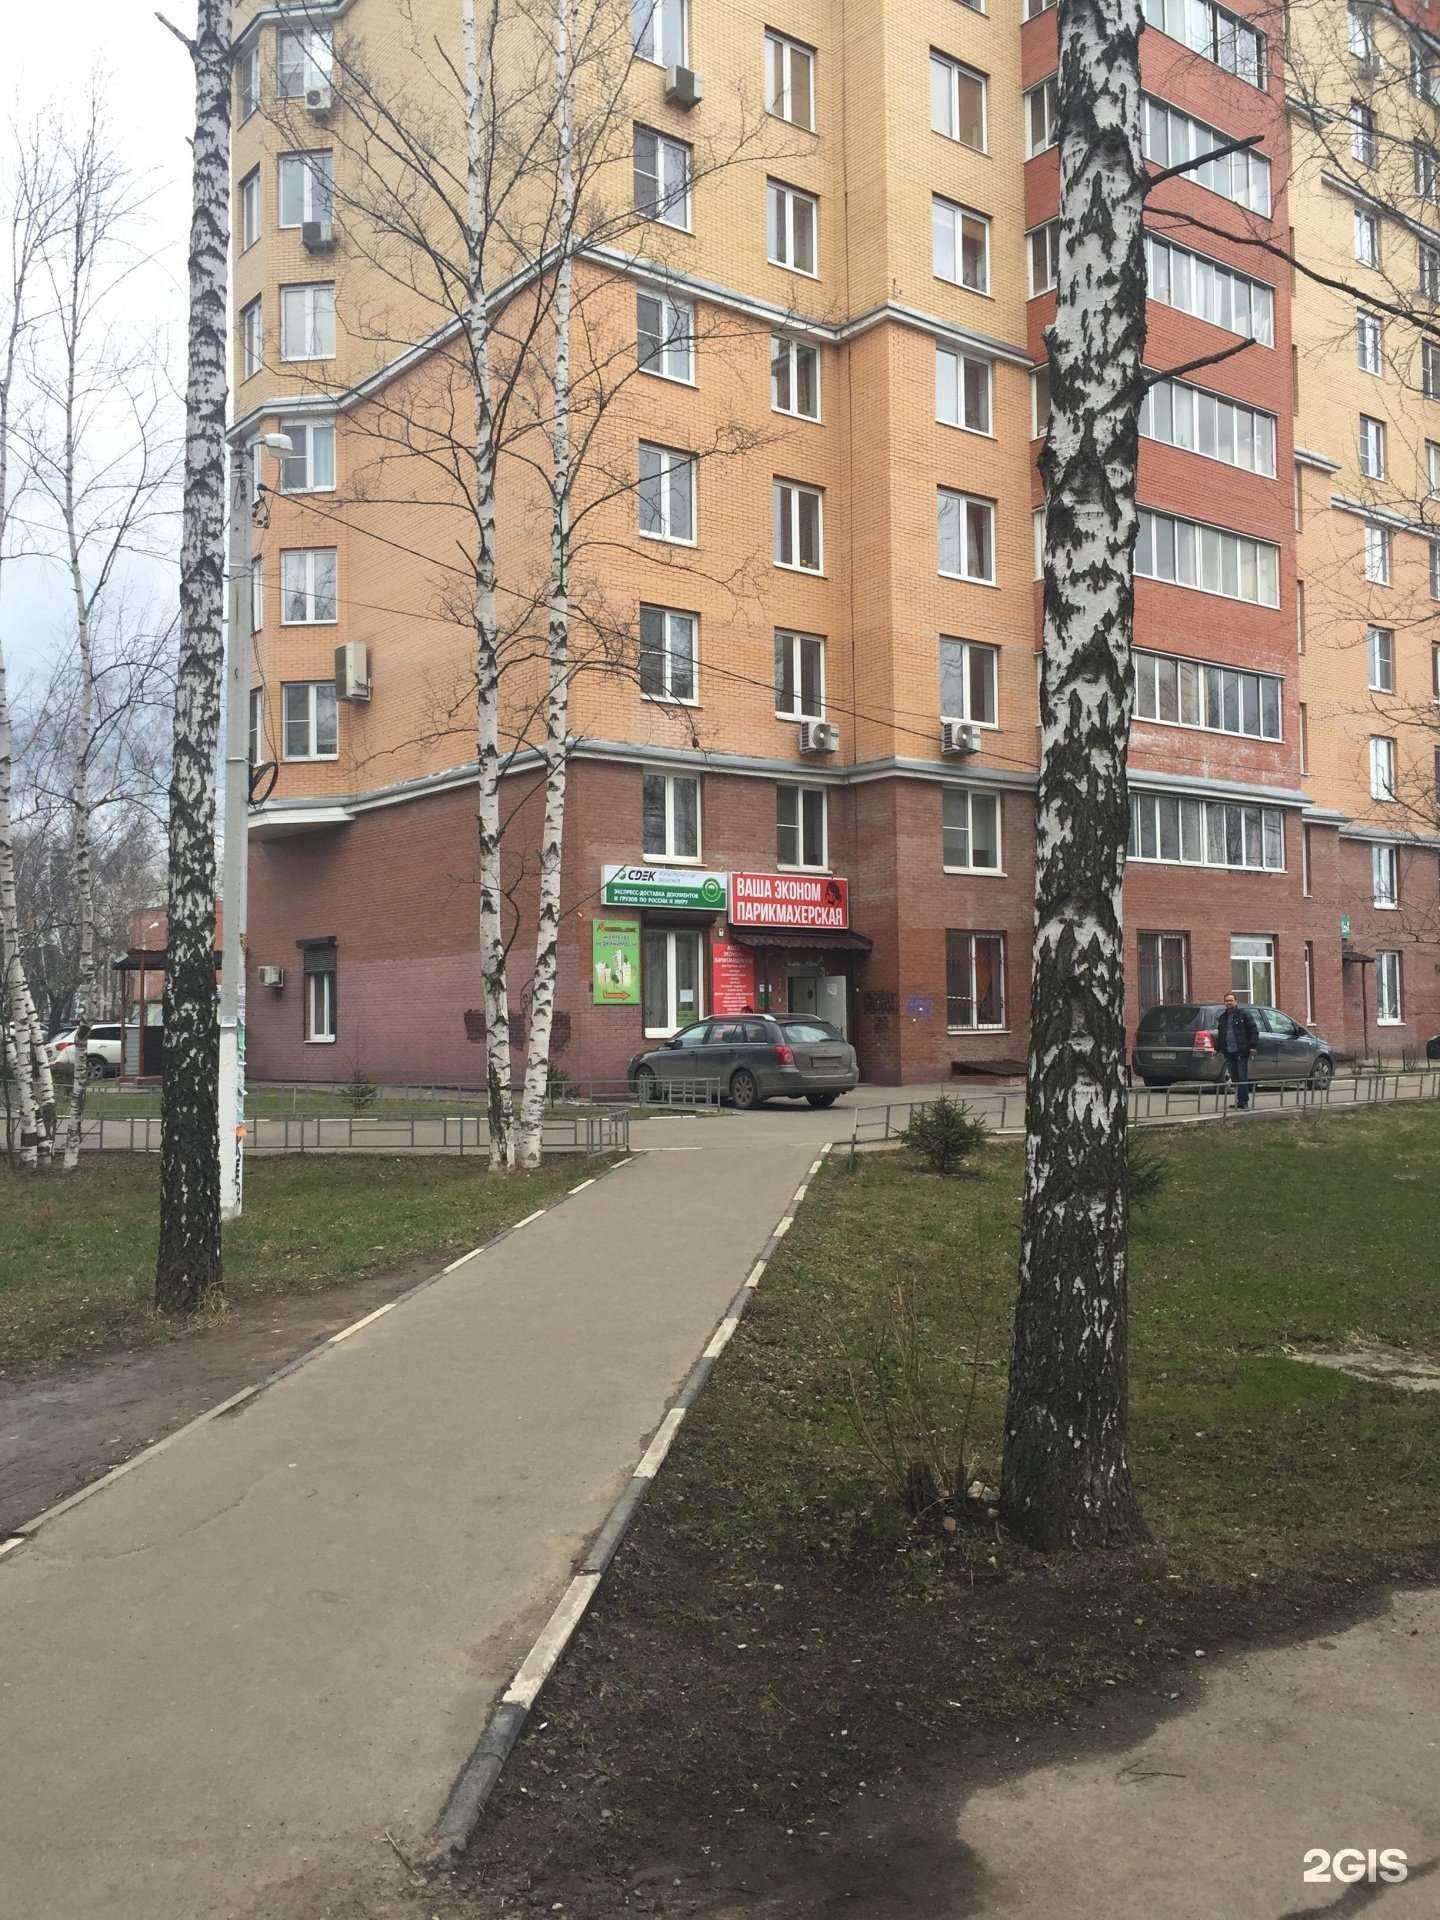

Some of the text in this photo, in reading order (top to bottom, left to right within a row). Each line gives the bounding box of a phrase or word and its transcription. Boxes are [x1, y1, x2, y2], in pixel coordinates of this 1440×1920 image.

[628, 870, 656, 881] CDEK
[736, 877, 821, 901] ВАША ЭКОНОМ
[736, 902, 843, 926] ПАРИКМАХЕРСКАЯ
